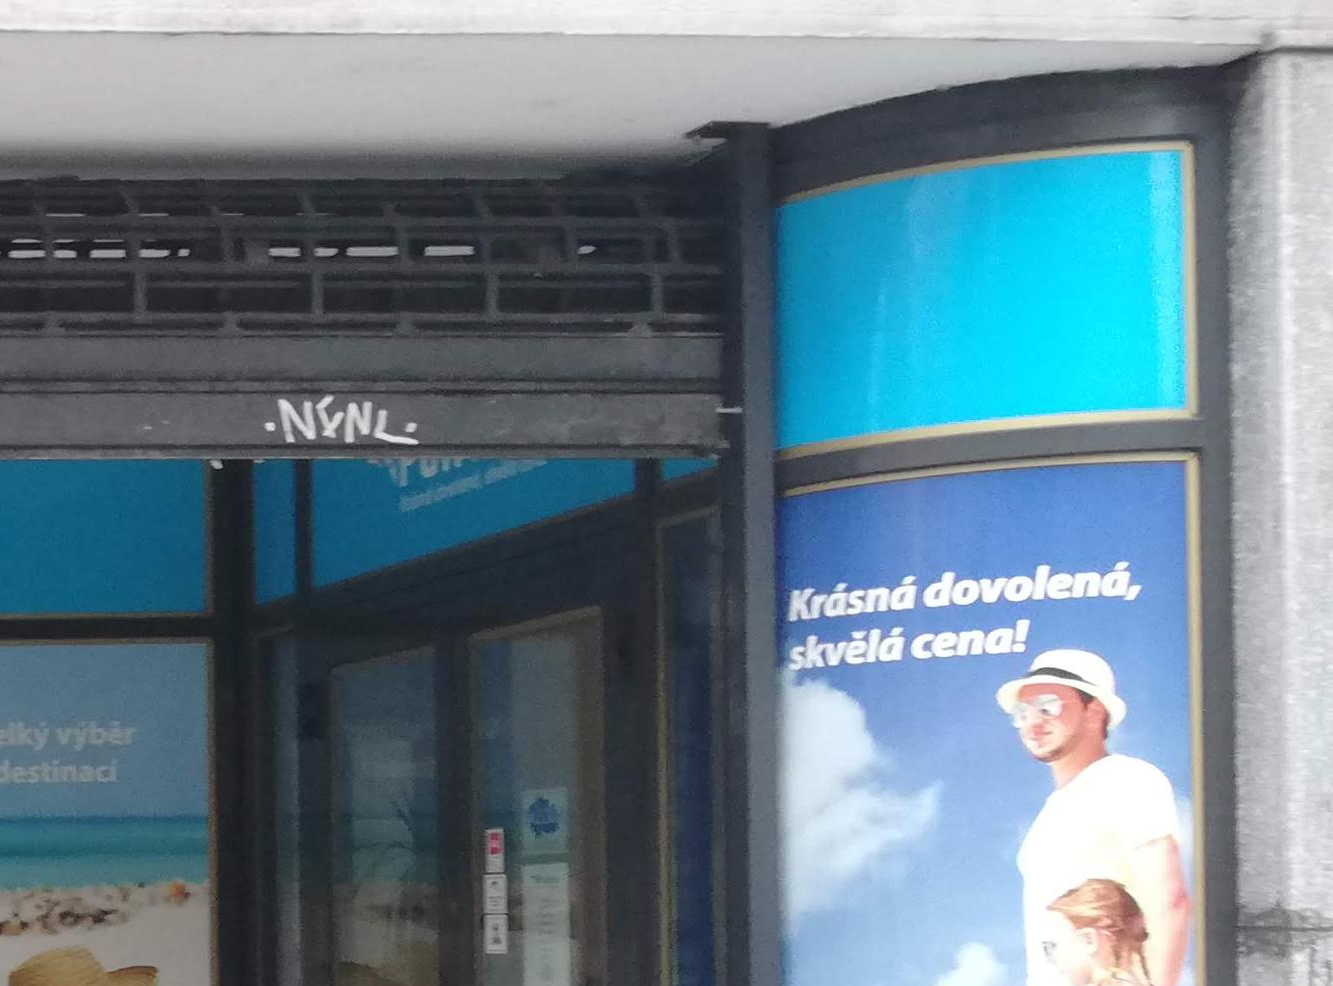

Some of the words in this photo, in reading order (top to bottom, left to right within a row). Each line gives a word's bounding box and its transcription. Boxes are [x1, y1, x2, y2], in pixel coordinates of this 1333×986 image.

[788, 576, 917, 622] Krásná
[923, 561, 1142, 608] dovolená,
[788, 627, 905, 671] skvělá
[910, 619, 1031, 658] cena!
[56, 720, 136, 752] výběr
